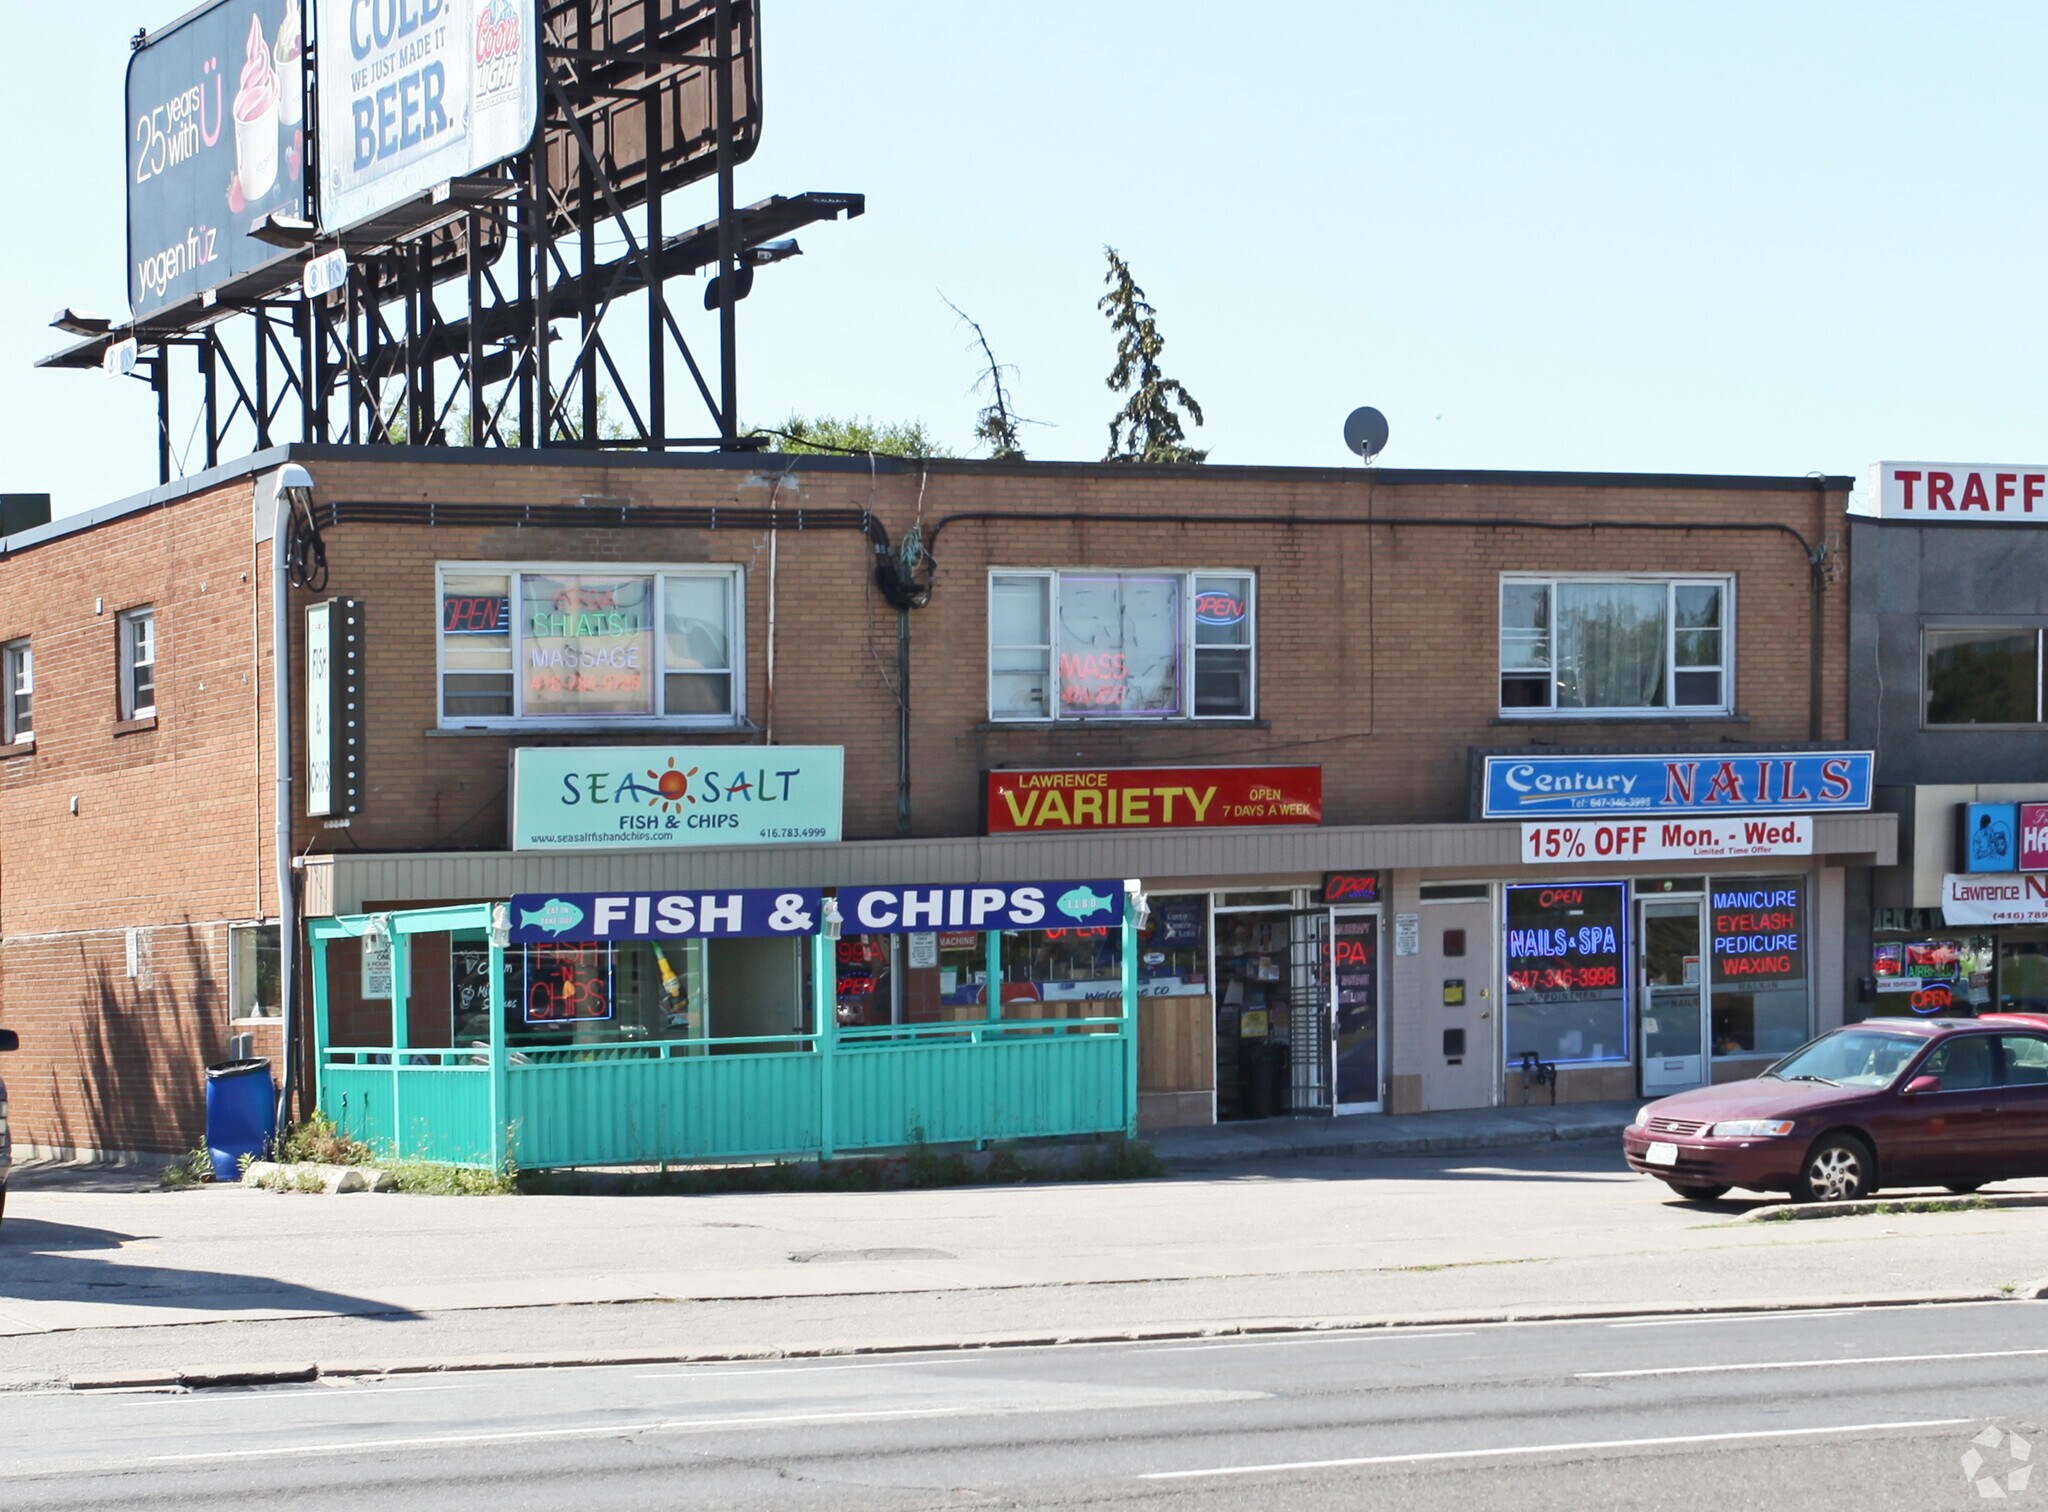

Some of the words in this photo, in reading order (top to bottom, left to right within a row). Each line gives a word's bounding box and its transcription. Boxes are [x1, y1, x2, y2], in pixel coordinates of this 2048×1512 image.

[475, 7, 520, 65] Coors
[351, 69, 368, 92] WE
[371, 53, 396, 84] JUST
[399, 34, 431, 69] MADE
[435, 27, 446, 50] IT
[476, 54, 519, 97] LIGHT
[352, 60, 453, 172] BEER.
[136, 106, 166, 184] 25
[166, 86, 200, 134] years
[168, 119, 199, 167] with
[139, 243, 186, 304] yogen
[1894, 470, 2045, 513] TRAFF
[532, 612, 640, 638] SHIATSU
[531, 646, 641, 669] MASSAGE
[561, 771, 641, 805] SEA
[702, 768, 801, 803] SALT
[1019, 773, 1108, 788] LAWRENCE
[1505, 764, 1637, 794] Century
[1660, 759, 1852, 805] NAILS
[1003, 786, 1217, 826] VARIETY
[1249, 788, 1281, 801] OPEN
[1570, 798, 1588, 808] Tel:
[619, 815, 659, 830] FISH
[664, 815, 681, 829] &
[687, 813, 739, 829] CHIPS
[1223, 805, 1230, 817] 7
[1234, 804, 1264, 817] DAYS
[1268, 804, 1278, 816] A
[1279, 803, 1310, 816] WEEK
[531, 831, 673, 844] www.seasaltfishandchips.com
[759, 827, 826, 839] 416.783.4999
[1529, 827, 1585, 858] 15%
[1594, 826, 1647, 855] OFF
[1661, 823, 1719, 847] Mon.
[1744, 821, 1802, 844] Wed.
[1693, 847, 1725, 856] Limited
[1728, 846, 1748, 855] Time
[1751, 845, 1772, 854] Offer
[1539, 889, 1584, 908] OPEN
[1713, 890, 1797, 909] MANICURE
[1952, 882, 2020, 901] Lawrence
[593, 895, 742, 936] FISH
[767, 893, 815, 931] &
[857, 887, 1046, 928] CHIPS
[1717, 912, 1794, 932] EYELASH
[1993, 911, 2024, 920] (416)
[1510, 927, 1567, 957] NAILS
[1568, 937, 1576, 948] &
[1579, 926, 1616, 955] SPA
[1714, 933, 1798, 954] PEDICURE
[1722, 955, 1791, 975] WAXING
[1510, 966, 1616, 991] 647-346-3998
[530, 978, 607, 1018] CHIPS
[1910, 989, 1952, 1008] OPEN
